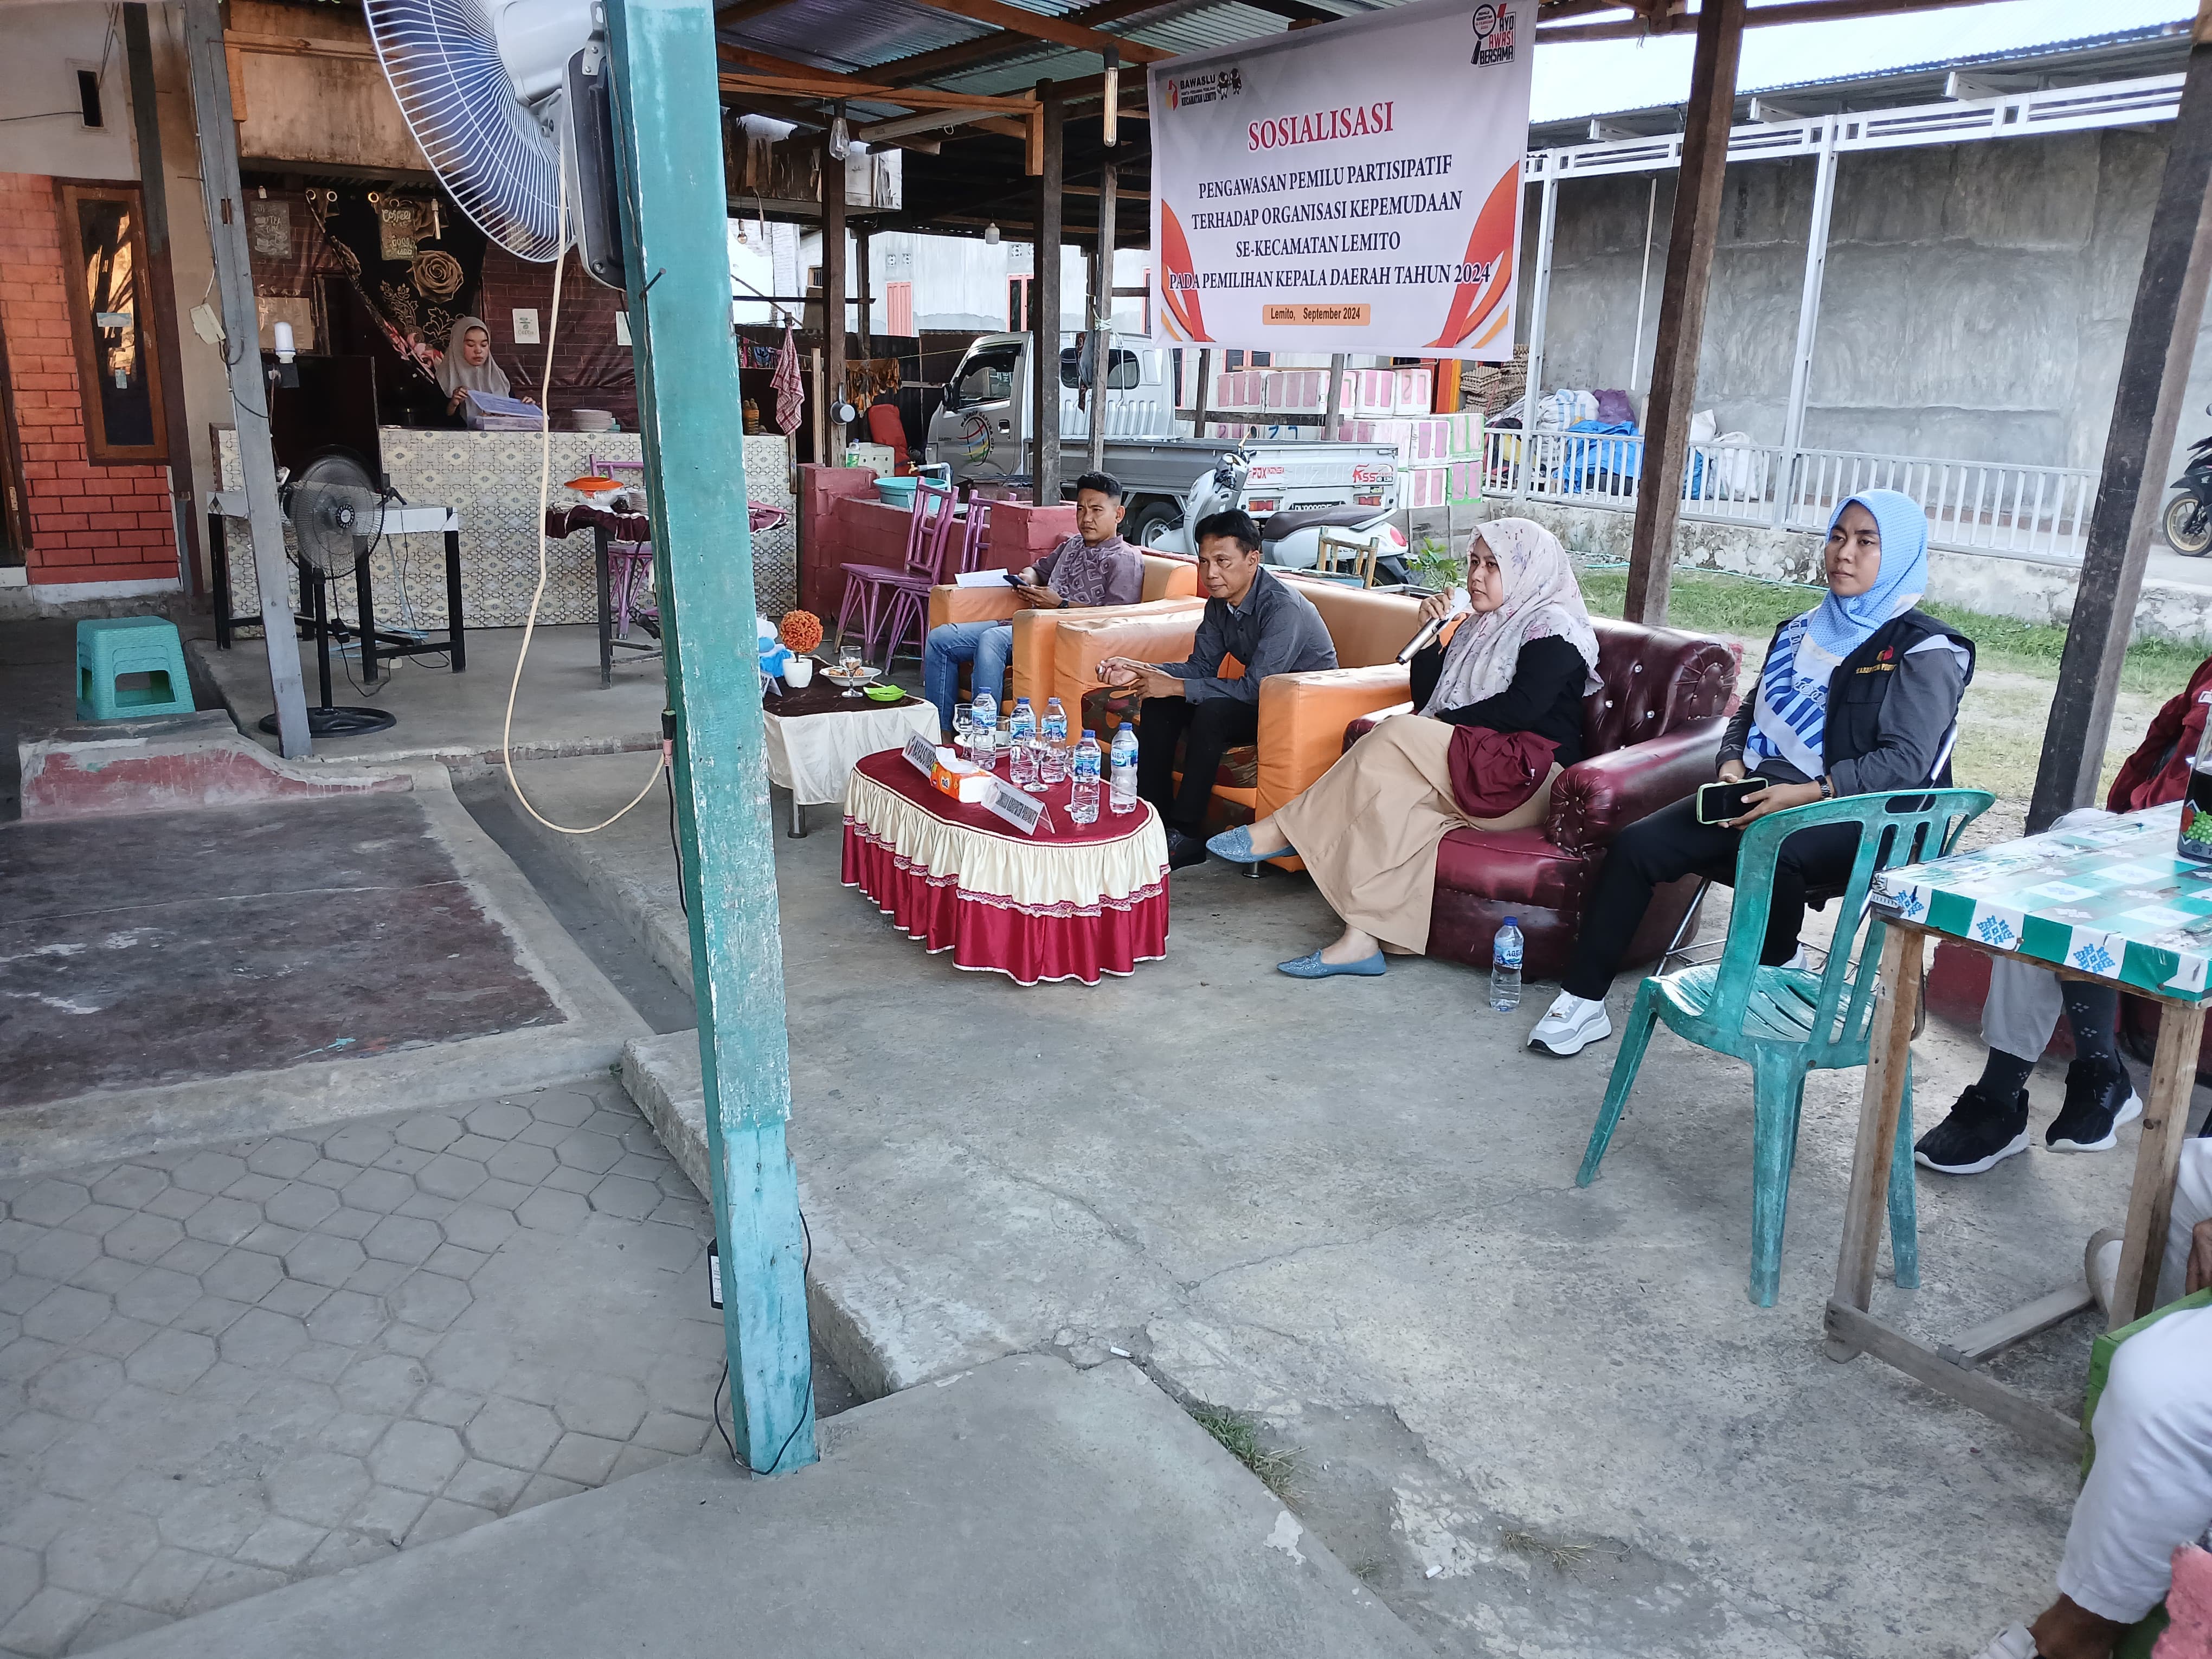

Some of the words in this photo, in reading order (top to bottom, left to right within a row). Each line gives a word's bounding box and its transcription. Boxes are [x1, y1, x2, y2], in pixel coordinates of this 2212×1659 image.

[1500, 15, 1514, 31] AYO
[1489, 30, 1513, 48] AWASI
[1480, 46, 1513, 65] BERSAMA
[1180, 74, 1216, 89] BAWASLU
[1181, 94, 1203, 106] KECAMATAN
[1203, 91, 1217, 102] LEMITO
[1249, 101, 1393, 150] SOSIALISASI
[1199, 173, 1287, 198] PENGAWASAN
[1289, 167, 1344, 190] PEMILU
[1347, 155, 1452, 184] PARTISIPATIF
[1192, 209, 1259, 229] TERHADAP
[1262, 201, 1347, 225] ORGANISASI
[1349, 190, 1463, 218] KEPEMUDAAN
[1236, 235, 1339, 258] SE-KECAMATAN
[1341, 231, 1400, 252] LEMITO
[1169, 274, 1200, 289] PADA
[1203, 271, 1274, 289] PEMILIHAN
[1276, 269, 1327, 287] KEPALA
[1330, 266, 1391, 285] DAERAH
[1394, 264, 1451, 284] TAHUN
[1454, 263, 1490, 282] 2024
[1271, 308, 1296, 321] Lemito,
[1303, 307, 1341, 322] September
[1343, 307, 1360, 319] 2024
